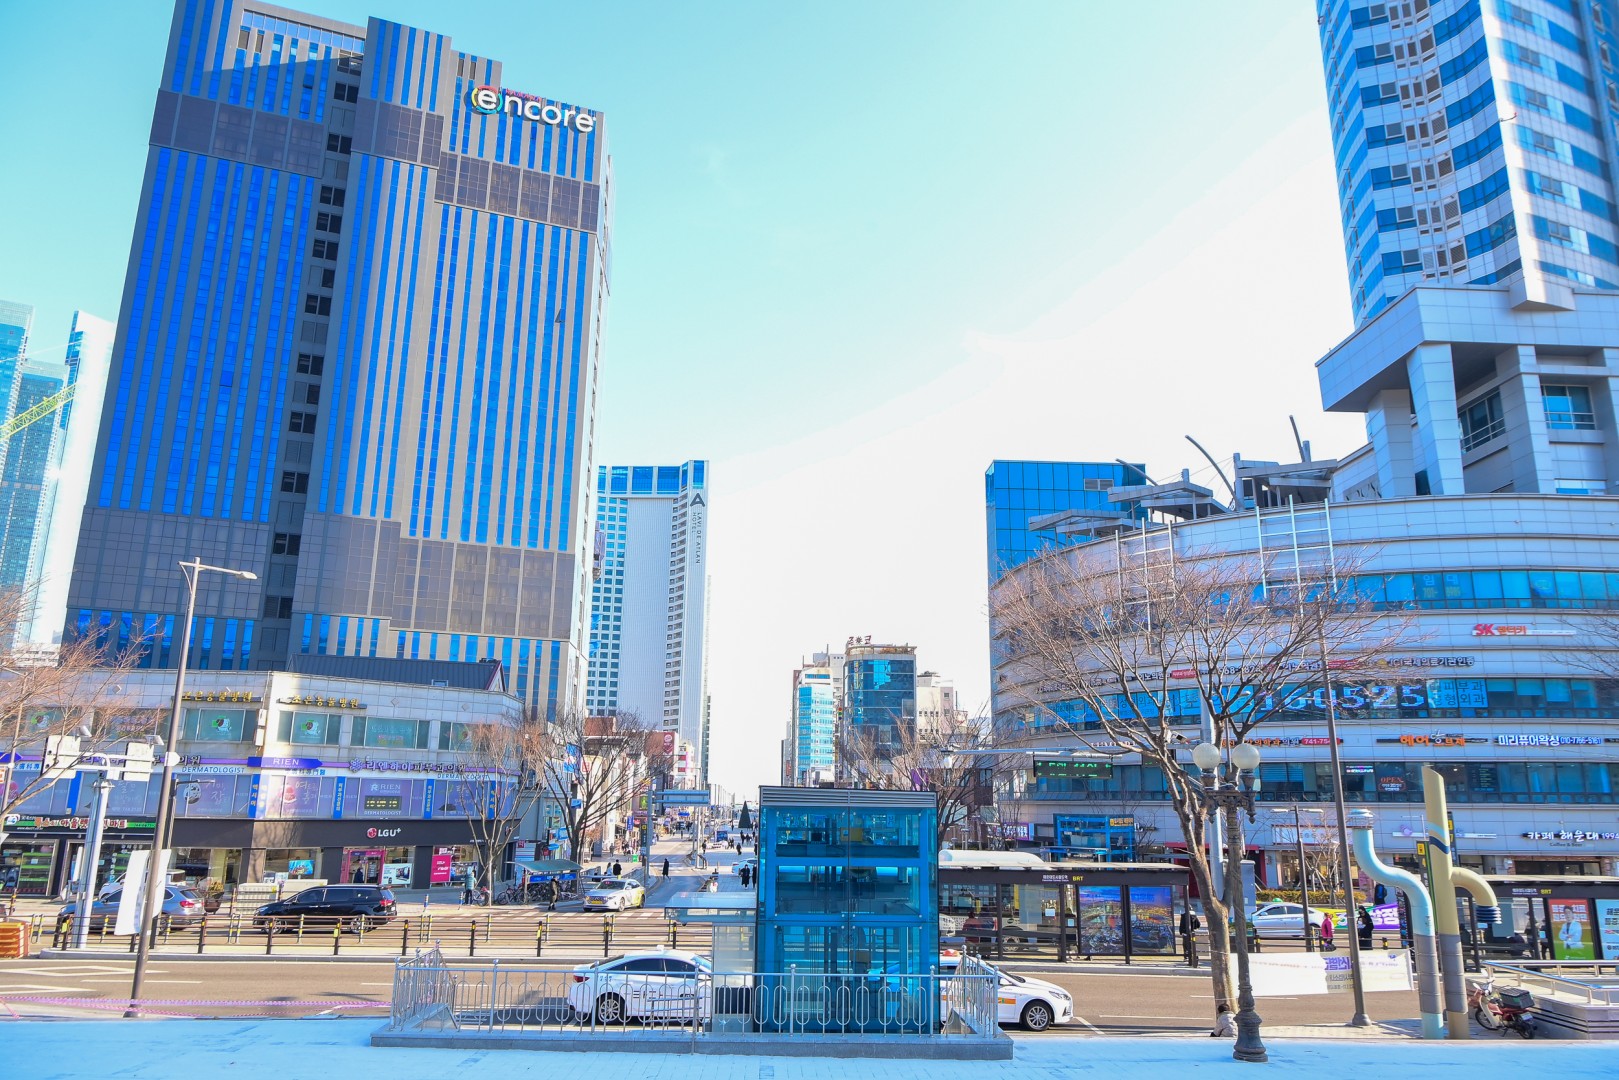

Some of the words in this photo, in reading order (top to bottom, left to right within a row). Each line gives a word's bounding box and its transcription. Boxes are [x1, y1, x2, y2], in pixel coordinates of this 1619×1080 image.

[478, 89, 594, 133] encore
[1475, 623, 1495, 635] SK
[1496, 625, 1527, 635] 렌터카
[1399, 735, 1430, 747] 헤어
[1498, 734, 1560, 747] 미리퓨어왁싱
[272, 758, 300, 766] RIEN
[181, 766, 245, 774] DERMATOLOGIST
[1527, 831, 1555, 840] 카페
[1559, 830, 1600, 842] 해운대
